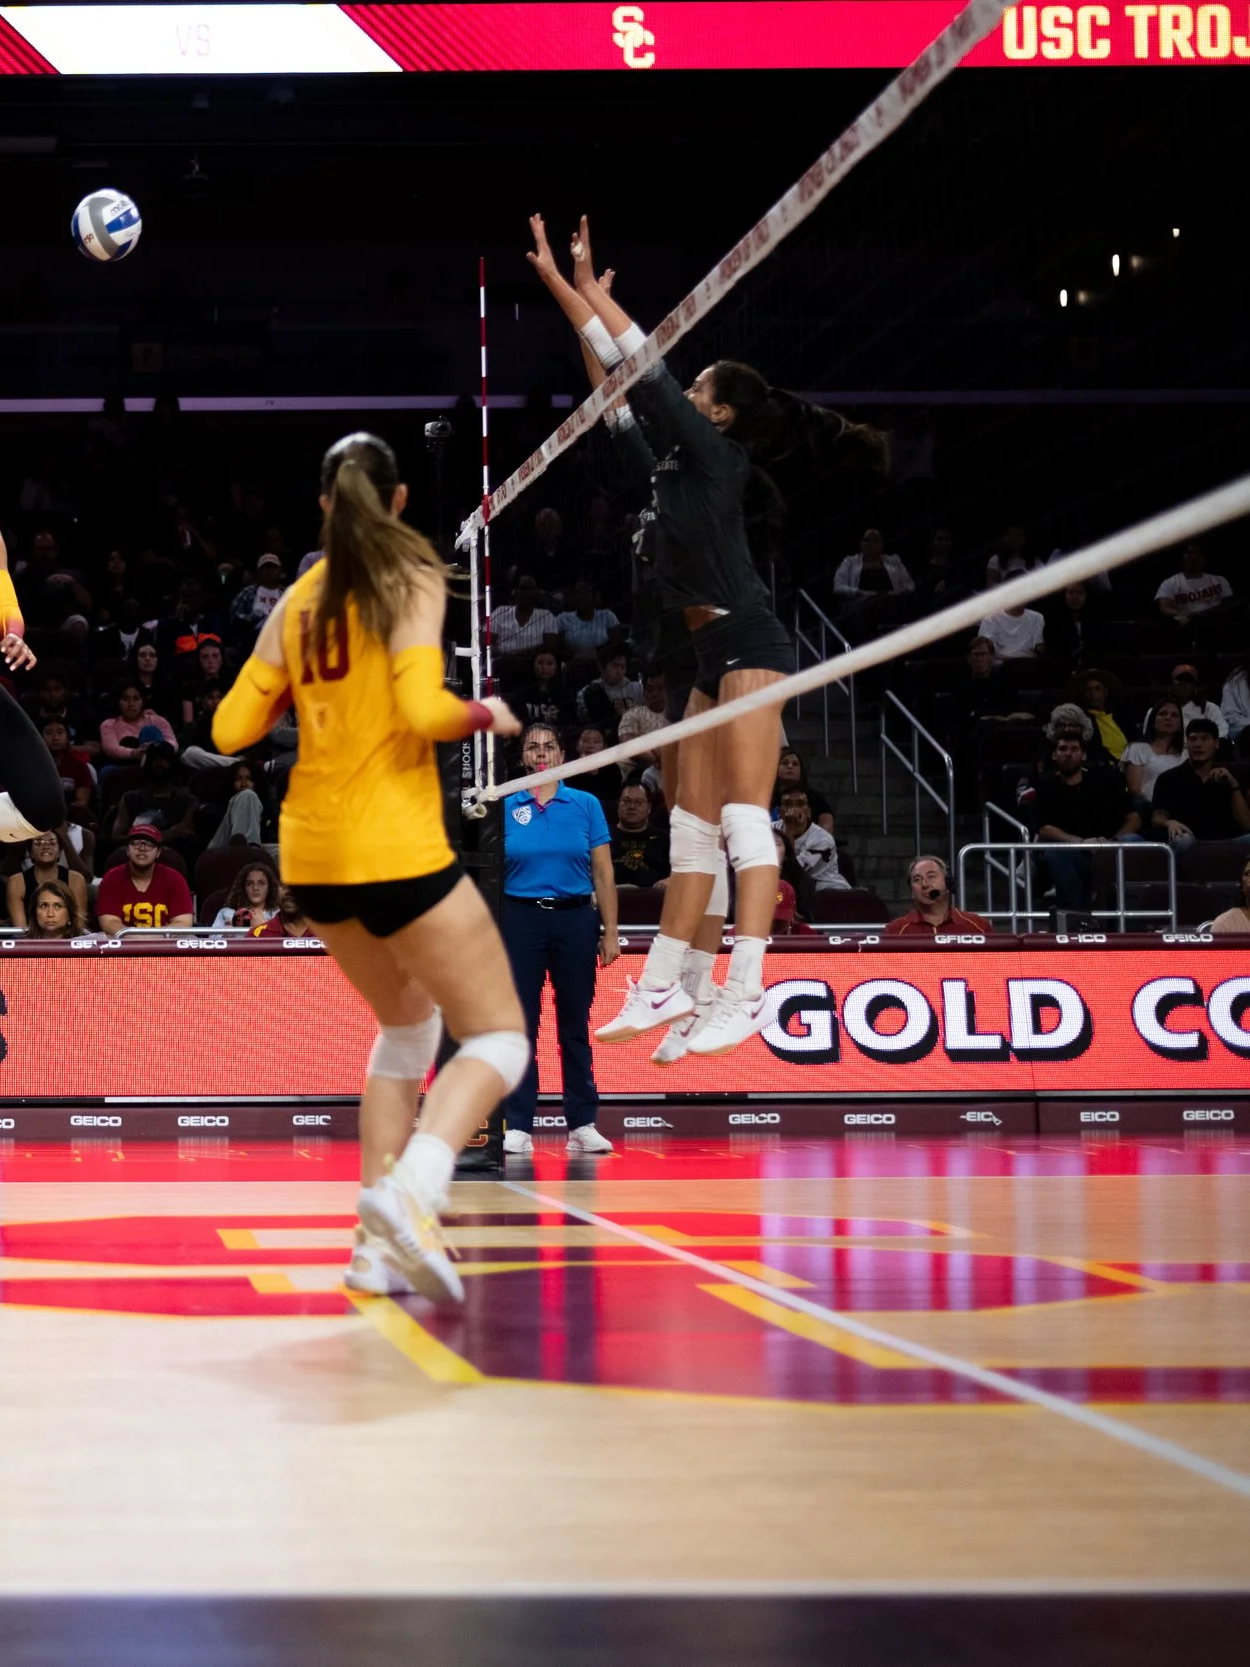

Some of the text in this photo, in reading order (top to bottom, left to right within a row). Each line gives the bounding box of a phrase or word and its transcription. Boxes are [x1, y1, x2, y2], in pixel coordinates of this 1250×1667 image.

[1002, 4, 1111, 60] USC
[175, 24, 212, 57] VS
[299, 608, 350, 685] 10
[71, 939, 122, 949] GEO
[177, 939, 228, 949] GEICO
[1055, 933, 1107, 944] GICO
[760, 976, 1094, 1064] GOLD
[292, 1115, 331, 1126] GEIC
[728, 1113, 781, 1124] GEICO
[844, 1113, 896, 1124] GEICO
[960, 1111, 1002, 1126] EIC
[1079, 1111, 1120, 1122] EICO
[1183, 1110, 1235, 1121] GEICO
[70, 1116, 122, 1127] GEICO
[177, 1116, 229, 1127] GEICO
[532, 1116, 567, 1127] EICO
[624, 1116, 673, 1128] GEIC
